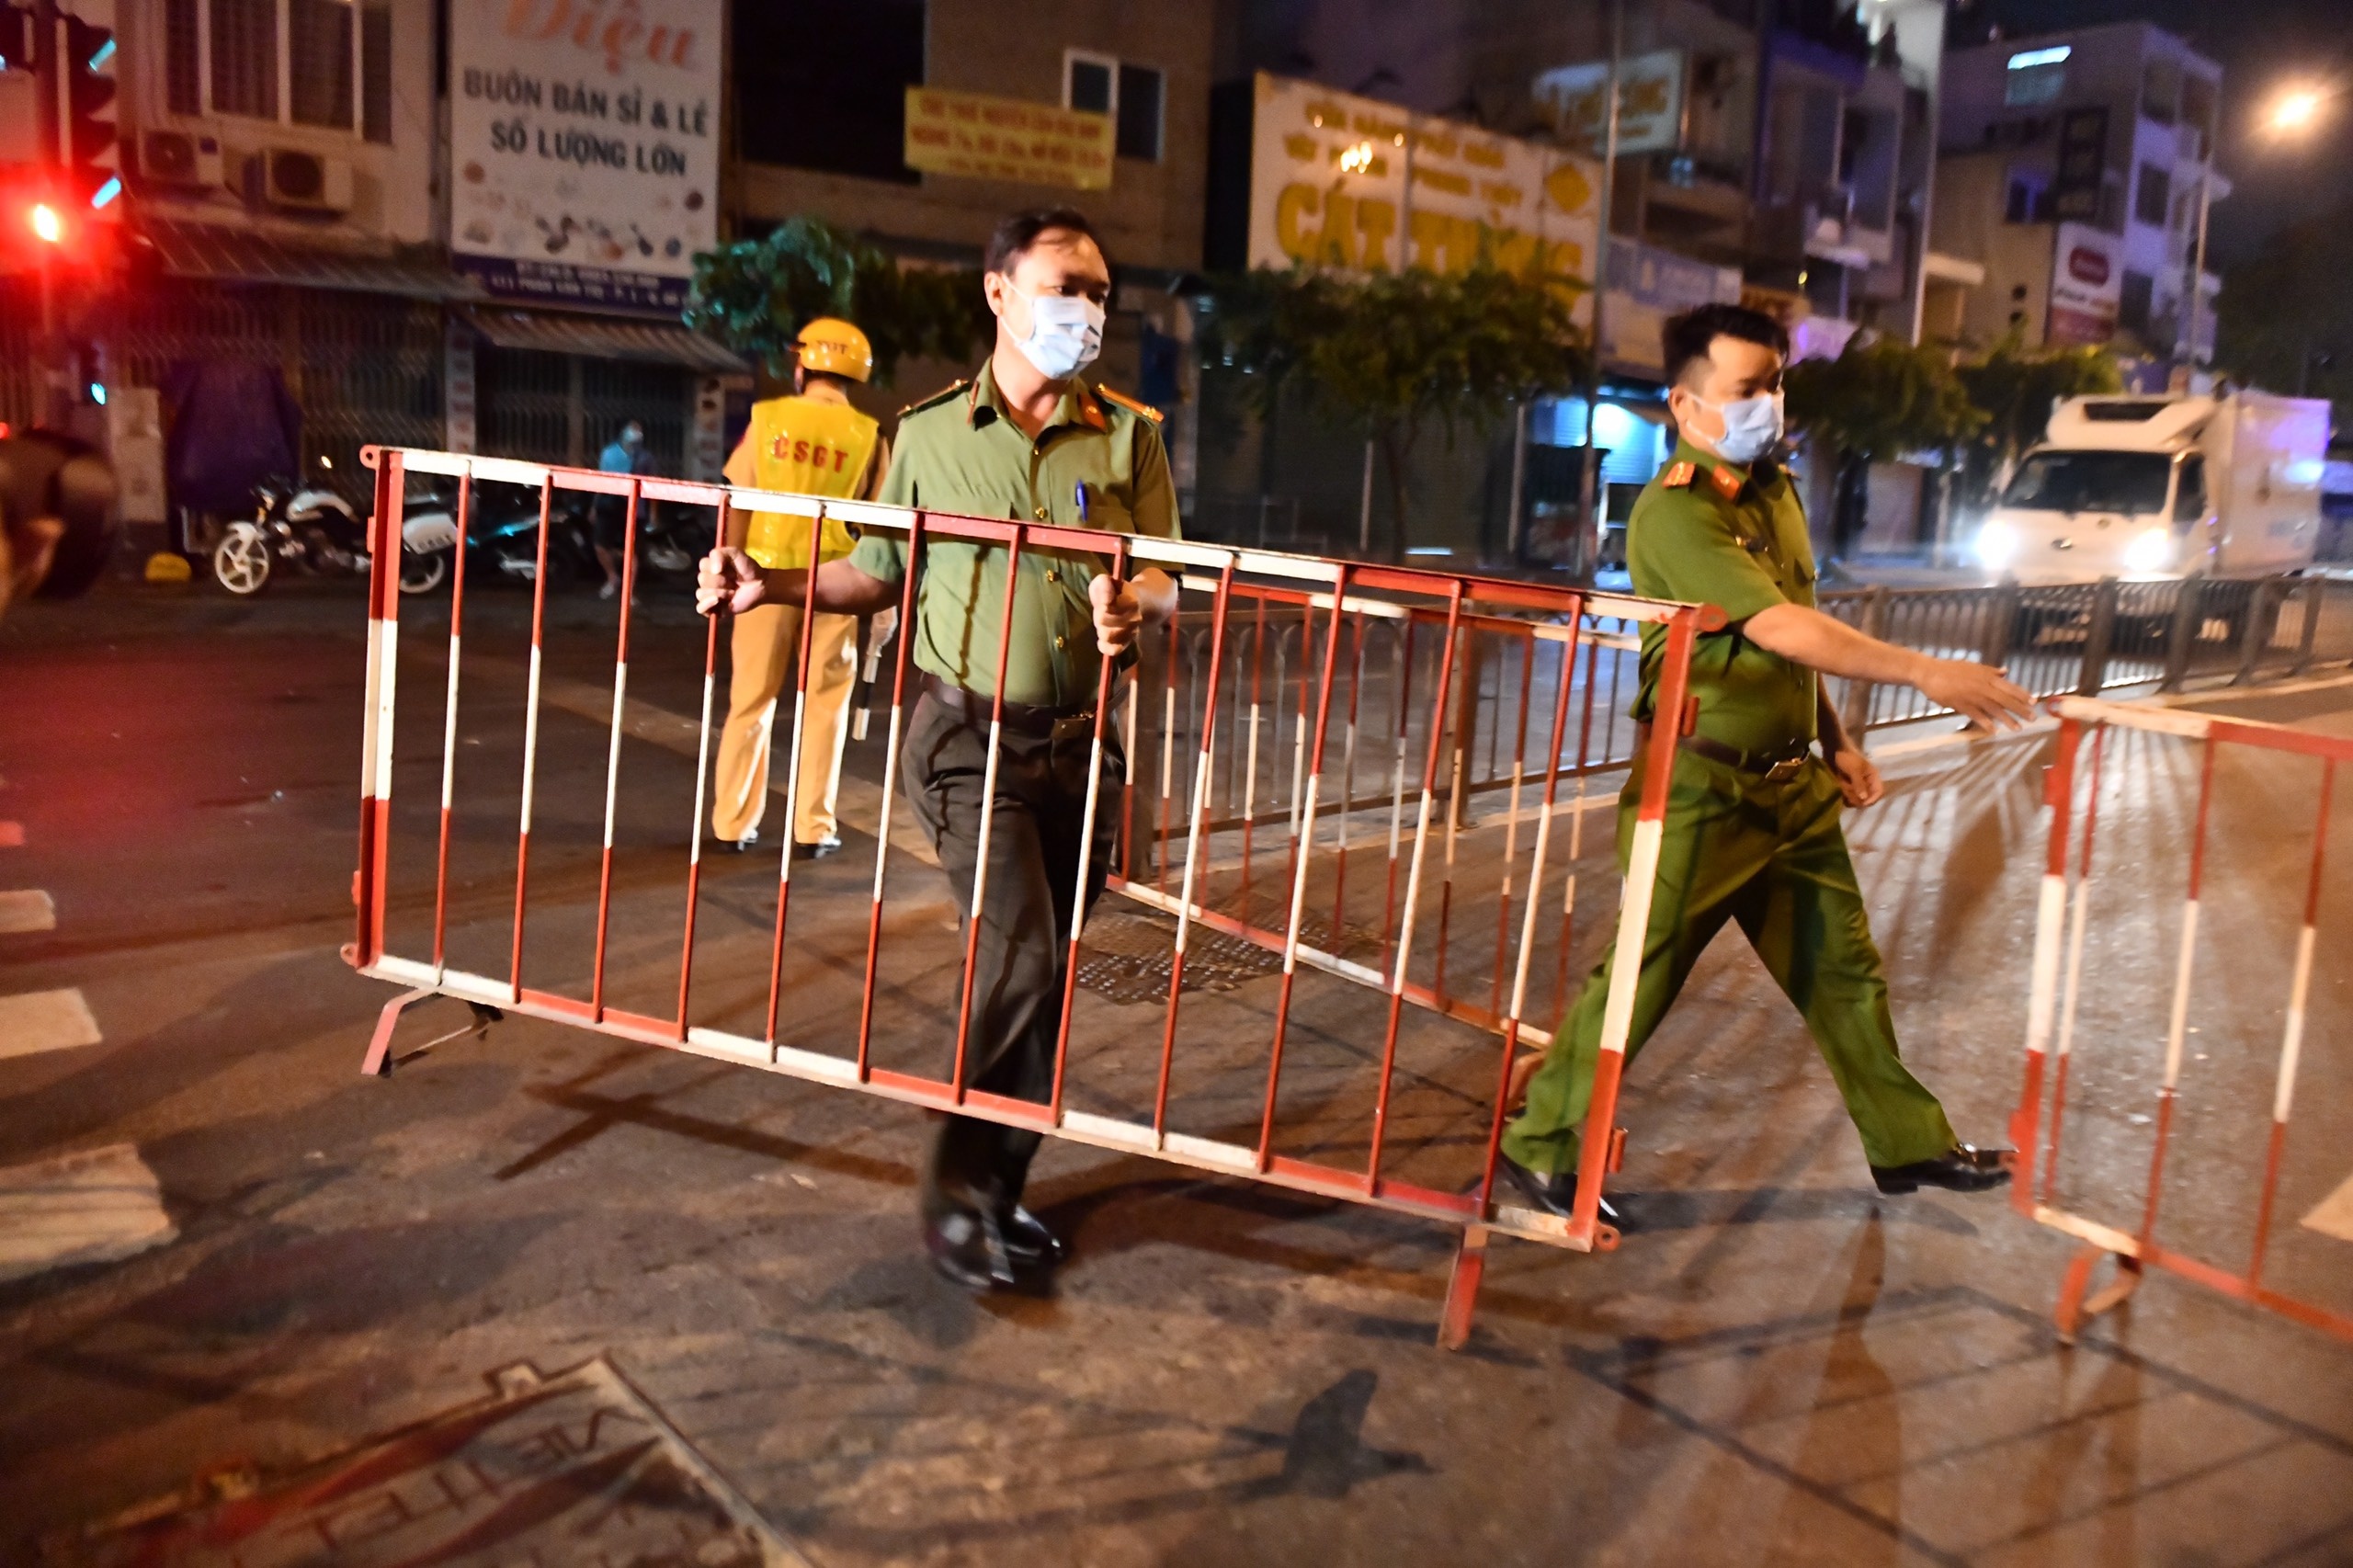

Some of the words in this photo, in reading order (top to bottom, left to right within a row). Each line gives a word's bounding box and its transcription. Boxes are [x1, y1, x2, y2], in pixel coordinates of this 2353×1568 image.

[464, 67, 542, 108] BUÔN
[551, 80, 608, 118] BÁN
[773, 436, 849, 473] CSGT
